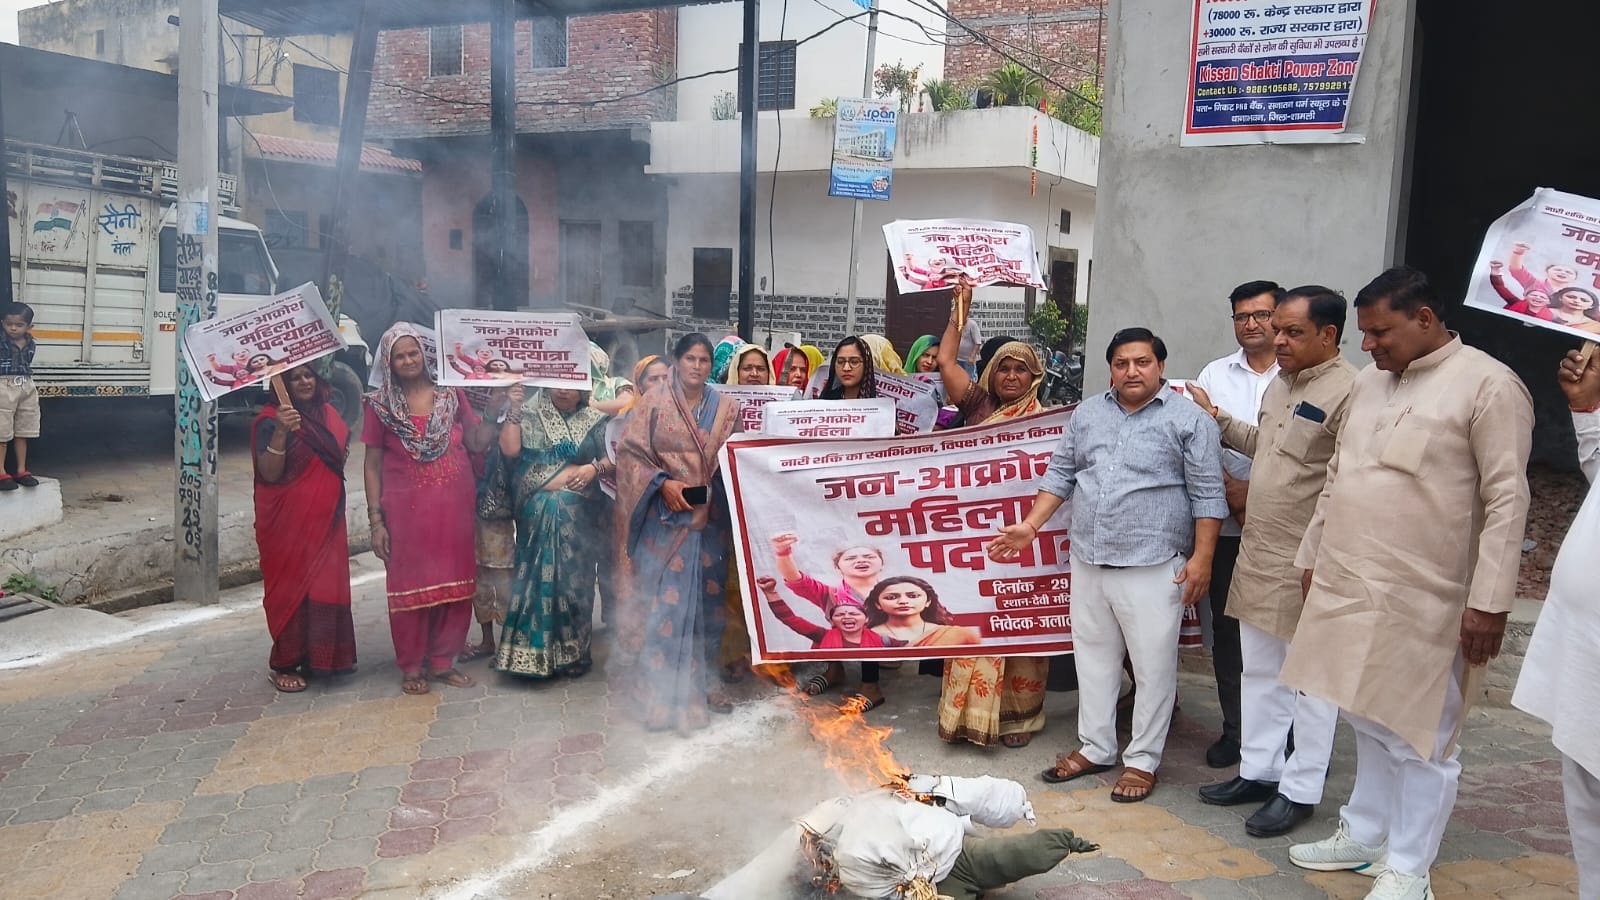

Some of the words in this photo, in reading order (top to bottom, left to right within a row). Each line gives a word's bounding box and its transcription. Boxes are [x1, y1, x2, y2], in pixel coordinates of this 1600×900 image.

[1208, 8, 1240, 24] (78000
[1294, 3, 1337, 15] सरकार
[1260, 24, 1287, 35] राज्य
[1290, 22, 1332, 33] सरकार
[1199, 63, 1239, 83] Kissan
[1240, 59, 1282, 80] Shakti
[1283, 59, 1325, 79] Power
[1197, 86, 1226, 96] Contact
[1227, 85, 1237, 94] Us
[97, 203, 141, 235] सैनी
[219, 300, 305, 338] जन-आक्रोश
[236, 317, 296, 346] महिला
[254, 318, 325, 351] पदयात्रा
[473, 326, 559, 337] जन-आक्रोश
[485, 336, 544, 349] महिला
[499, 350, 571, 361] पदयात्रा
[787, 414, 866, 425] जन-आक्रोश
[798, 425, 852, 437] महिला
[780, 455, 810, 467] नारी
[812, 452, 843, 465] शक्ति
[845, 452, 863, 462] का
[865, 442, 939, 461] स्वाभिमान,
[940, 438, 978, 452] विपक्ष
[980, 434, 994, 445] ने
[996, 431, 1025, 444] फिर
[1026, 425, 1064, 439] किया
[992, 579, 1035, 596] दिनांक
[1050, 577, 1069, 591] 29
[1002, 593, 1050, 609] स्थान-देवी
